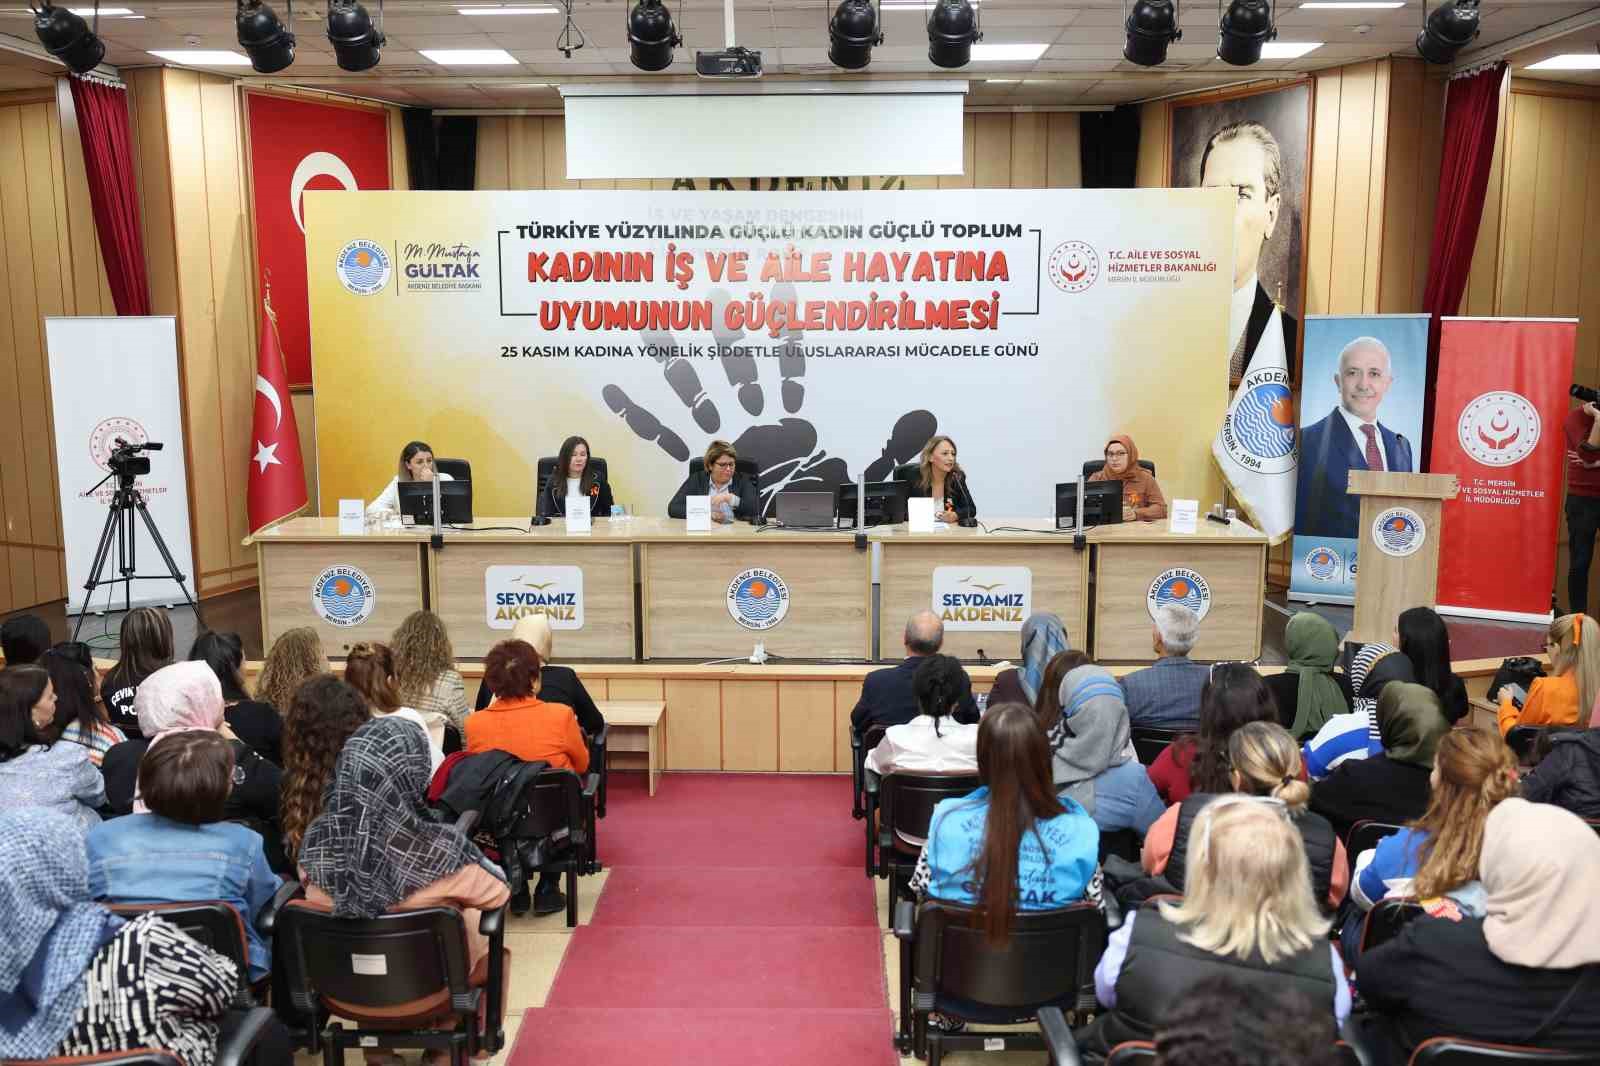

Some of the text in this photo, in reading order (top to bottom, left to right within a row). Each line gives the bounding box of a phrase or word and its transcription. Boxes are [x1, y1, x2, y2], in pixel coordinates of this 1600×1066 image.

[516, 221, 1022, 242] TÜRKİYE YÜZYILINDA GÜÇLÜ KADIN GÜÇLÜ TOPLUM
[1109, 250, 1201, 260] T.C. AİLE VE SOSYAL
[405, 263, 480, 278] GÜLTAK
[527, 251, 654, 282] KADININ
[665, 243, 694, 290] İŞ
[706, 251, 749, 282] VE
[760, 243, 832, 282] AİLE
[844, 250, 1009, 282] HAYATINA
[1108, 261, 1217, 273] HİZMETLER BAKANLIĞI
[539, 290, 1000, 337] UYUMUNUN GÜÇLENDİRİLMESİ
[501, 342, 1039, 360] 25 KASIM KADINA YÖNELİK ŞİDDETLE ULUSLARARASI MÜCADELE GÜNÜ
[1246, 372, 1289, 390] AKDEN
[1240, 454, 1262, 469] 1994
[337, 568, 373, 598] BELEDİYESİ
[753, 570, 788, 600] BELEDİYESİ
[1149, 570, 1209, 600] AKDENİZ BELEDİYESİ
[496, 593, 576, 605] SEVDAMIZ
[942, 593, 1024, 606] SEVDAMIZ
[942, 607, 1024, 621] AKDENİZ
